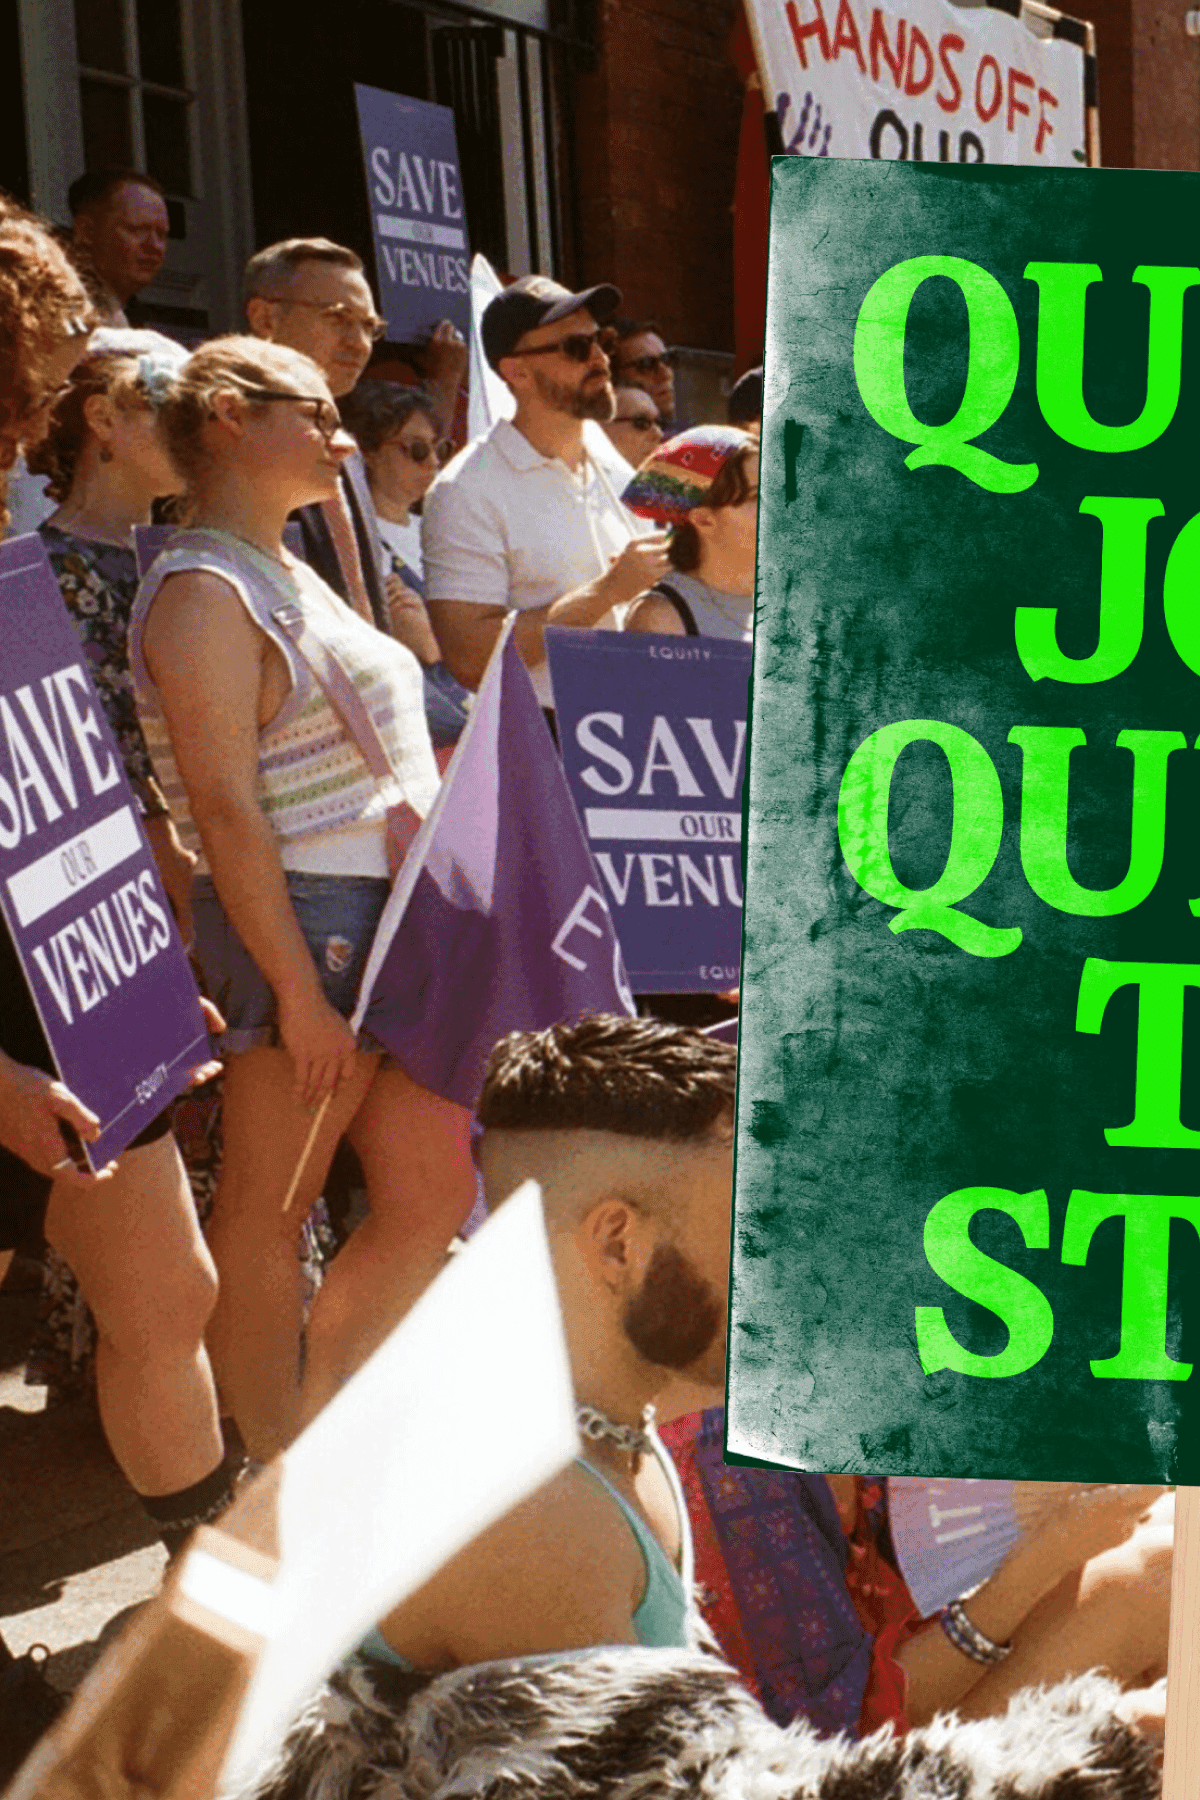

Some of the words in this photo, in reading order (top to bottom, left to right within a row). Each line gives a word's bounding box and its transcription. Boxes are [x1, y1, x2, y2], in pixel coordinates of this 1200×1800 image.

[785, 0, 966, 113] HANDS
[974, 54, 1059, 155] OFF
[371, 147, 461, 219] SAVE
[381, 244, 470, 294] VENUES
[649, 644, 712, 662] EQUITY
[680, 814, 735, 839] OUR
[59, 838, 99, 888] OUR
[32, 868, 171, 1026] VENUES
